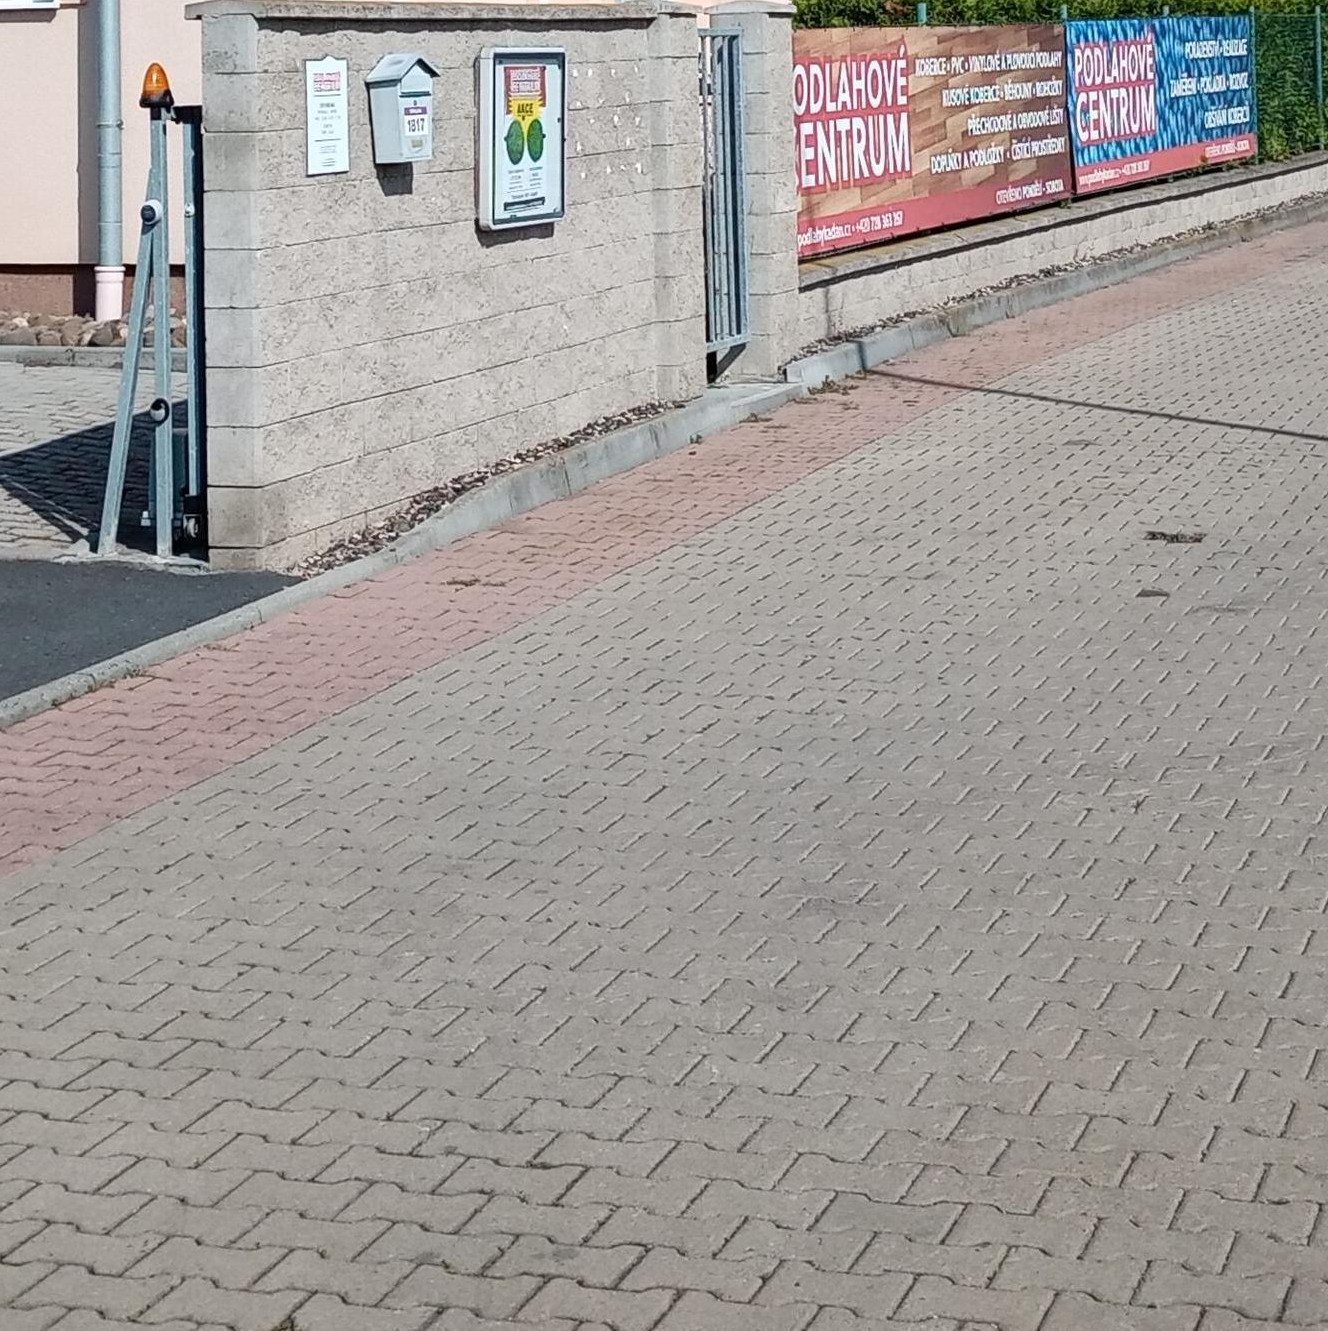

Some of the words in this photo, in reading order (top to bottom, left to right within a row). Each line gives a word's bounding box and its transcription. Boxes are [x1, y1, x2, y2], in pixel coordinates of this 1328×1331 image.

[793, 45, 908, 116] ODLAHOVÉ
[915, 57, 947, 76] KOBERCE
[951, 56, 964, 74] PVC
[1035, 51, 1062, 68] PODLAHY
[1074, 32, 1154, 87] PODLAHOVÉ
[970, 84, 1000, 103] KOBERCE
[1076, 84, 1156, 142] CENTRUM
[795, 112, 910, 188] ENTRUM
[963, 151, 969, 168] A
